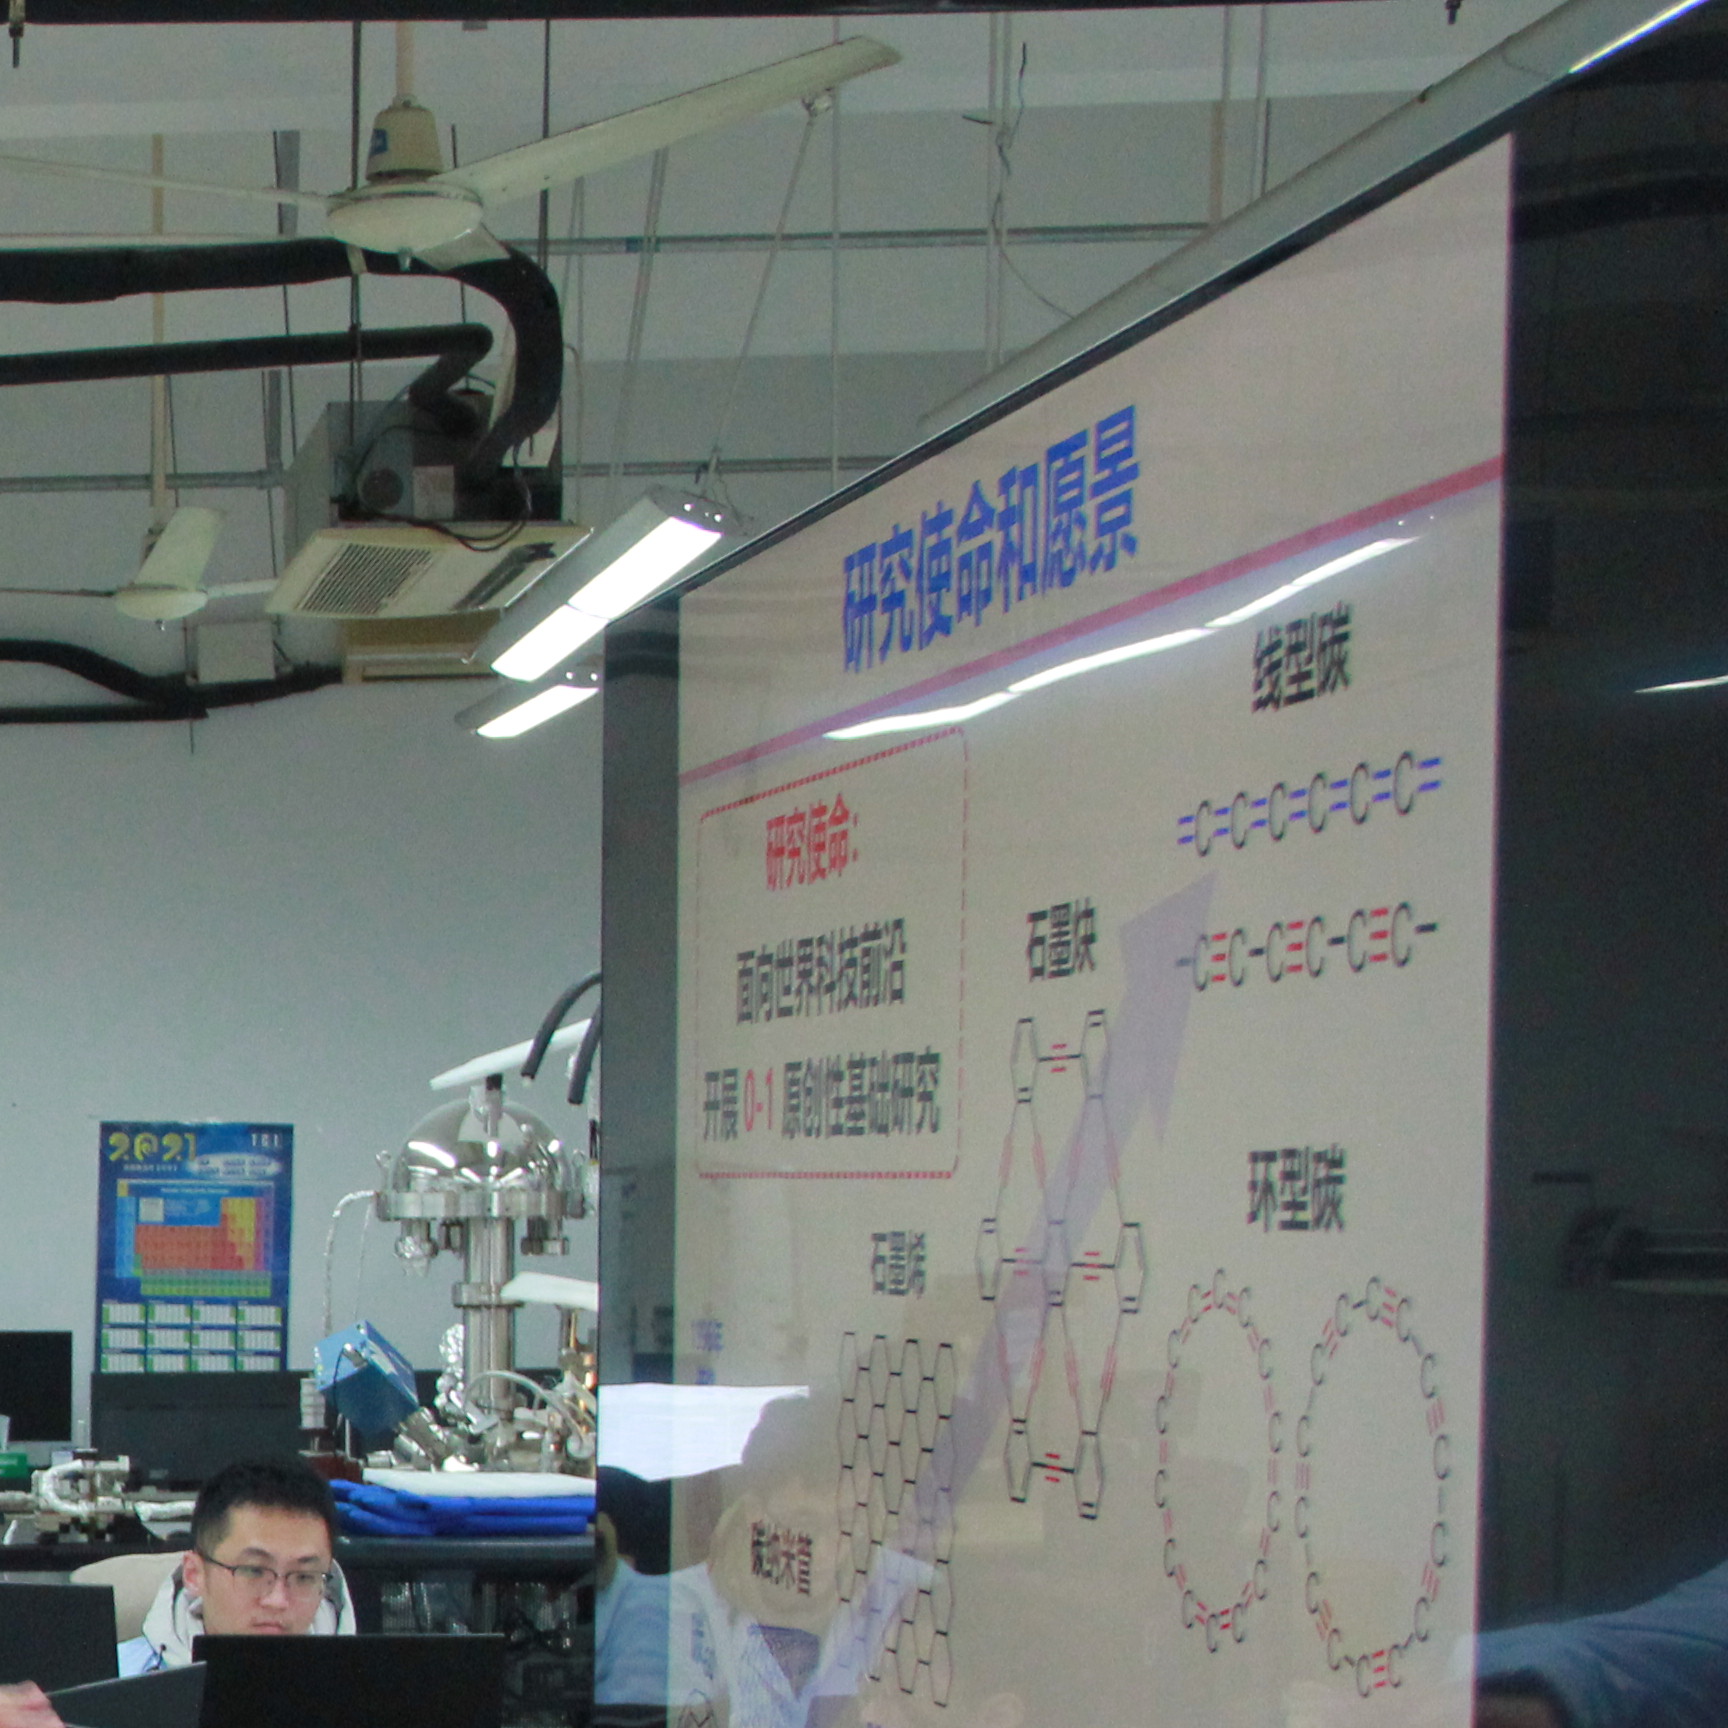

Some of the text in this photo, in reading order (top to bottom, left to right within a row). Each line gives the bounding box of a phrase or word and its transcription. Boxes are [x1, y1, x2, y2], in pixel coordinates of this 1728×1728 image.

[842, 405, 1141, 674] 研究使命和愿景
[1252, 601, 1352, 713] 线型碳
[766, 793, 859, 892] 研究使命：
[736, 917, 906, 1025] 面向世界科技前沿
[703, 1045, 941, 1142] 开展 0-1 原创性基础研究
[1247, 1143, 1346, 1232] 环型碳
